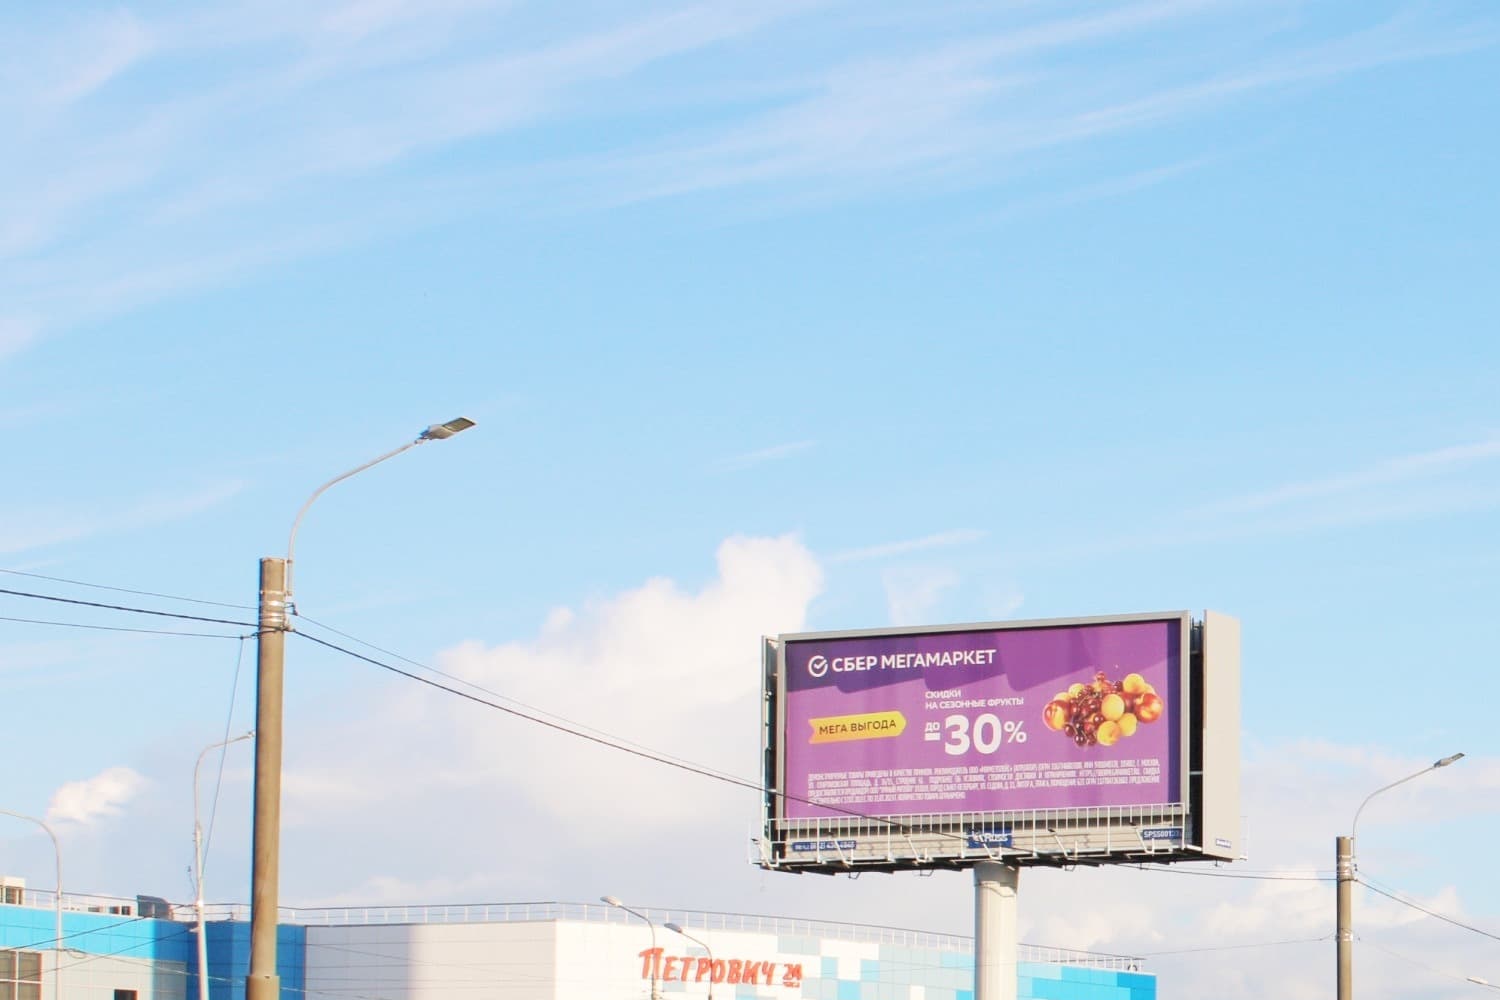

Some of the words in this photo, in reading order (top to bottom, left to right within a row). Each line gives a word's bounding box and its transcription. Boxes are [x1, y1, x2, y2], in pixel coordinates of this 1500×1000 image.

[832, 655, 878, 672] СБЕР
[881, 649, 997, 670] МЕГАМАРКЕТ
[925, 689, 962, 699] СКИДКИ
[925, 701, 938, 710] НА
[939, 699, 986, 709] СЕЗОННЫЕ
[987, 697, 1024, 706] ФРУКТЫ
[818, 724, 847, 735] МЕГА
[851, 719, 897, 733] ВЫГОДА
[925, 721, 940, 732] ДО
